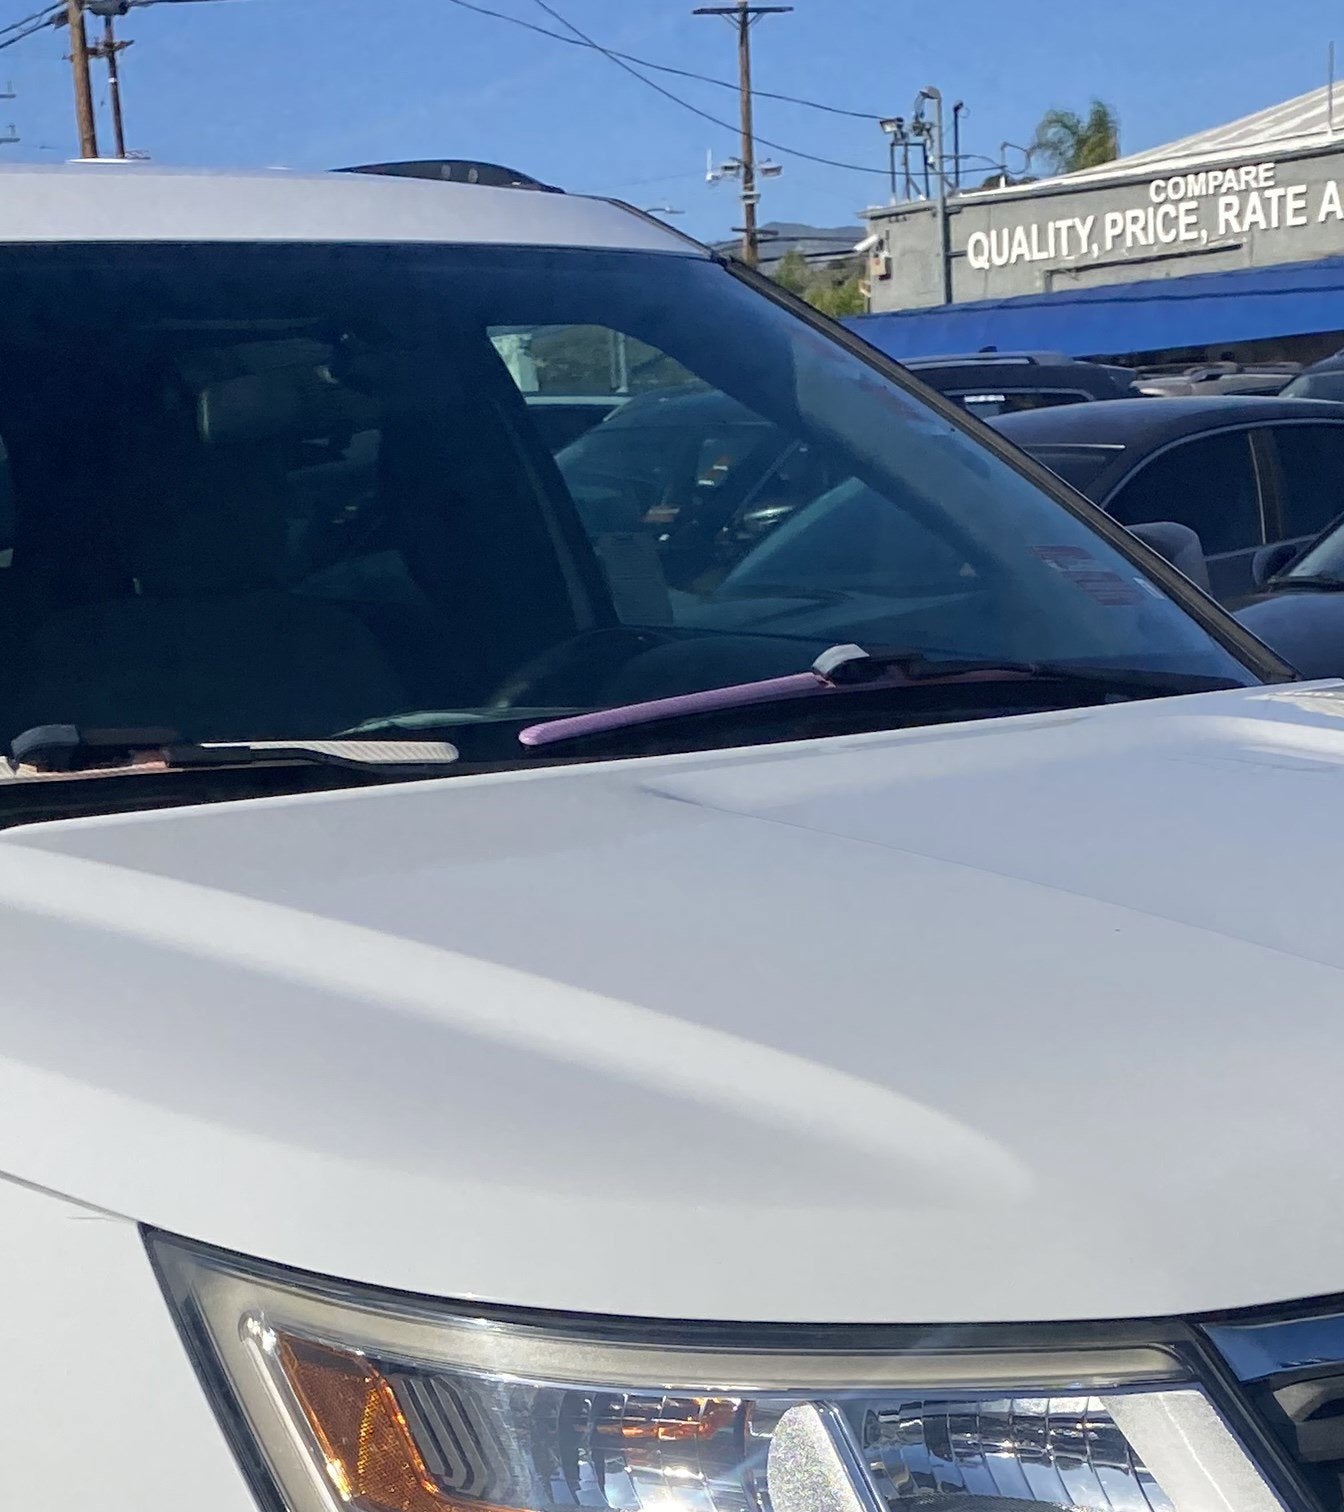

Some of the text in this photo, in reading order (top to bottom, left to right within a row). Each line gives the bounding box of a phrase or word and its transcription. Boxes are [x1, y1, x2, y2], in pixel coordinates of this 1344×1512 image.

[1149, 162, 1275, 203] COMPARE
[967, 215, 1099, 269] QUALITY,
[1105, 201, 1208, 249] PRICE,
[1218, 184, 1307, 235] RATE
